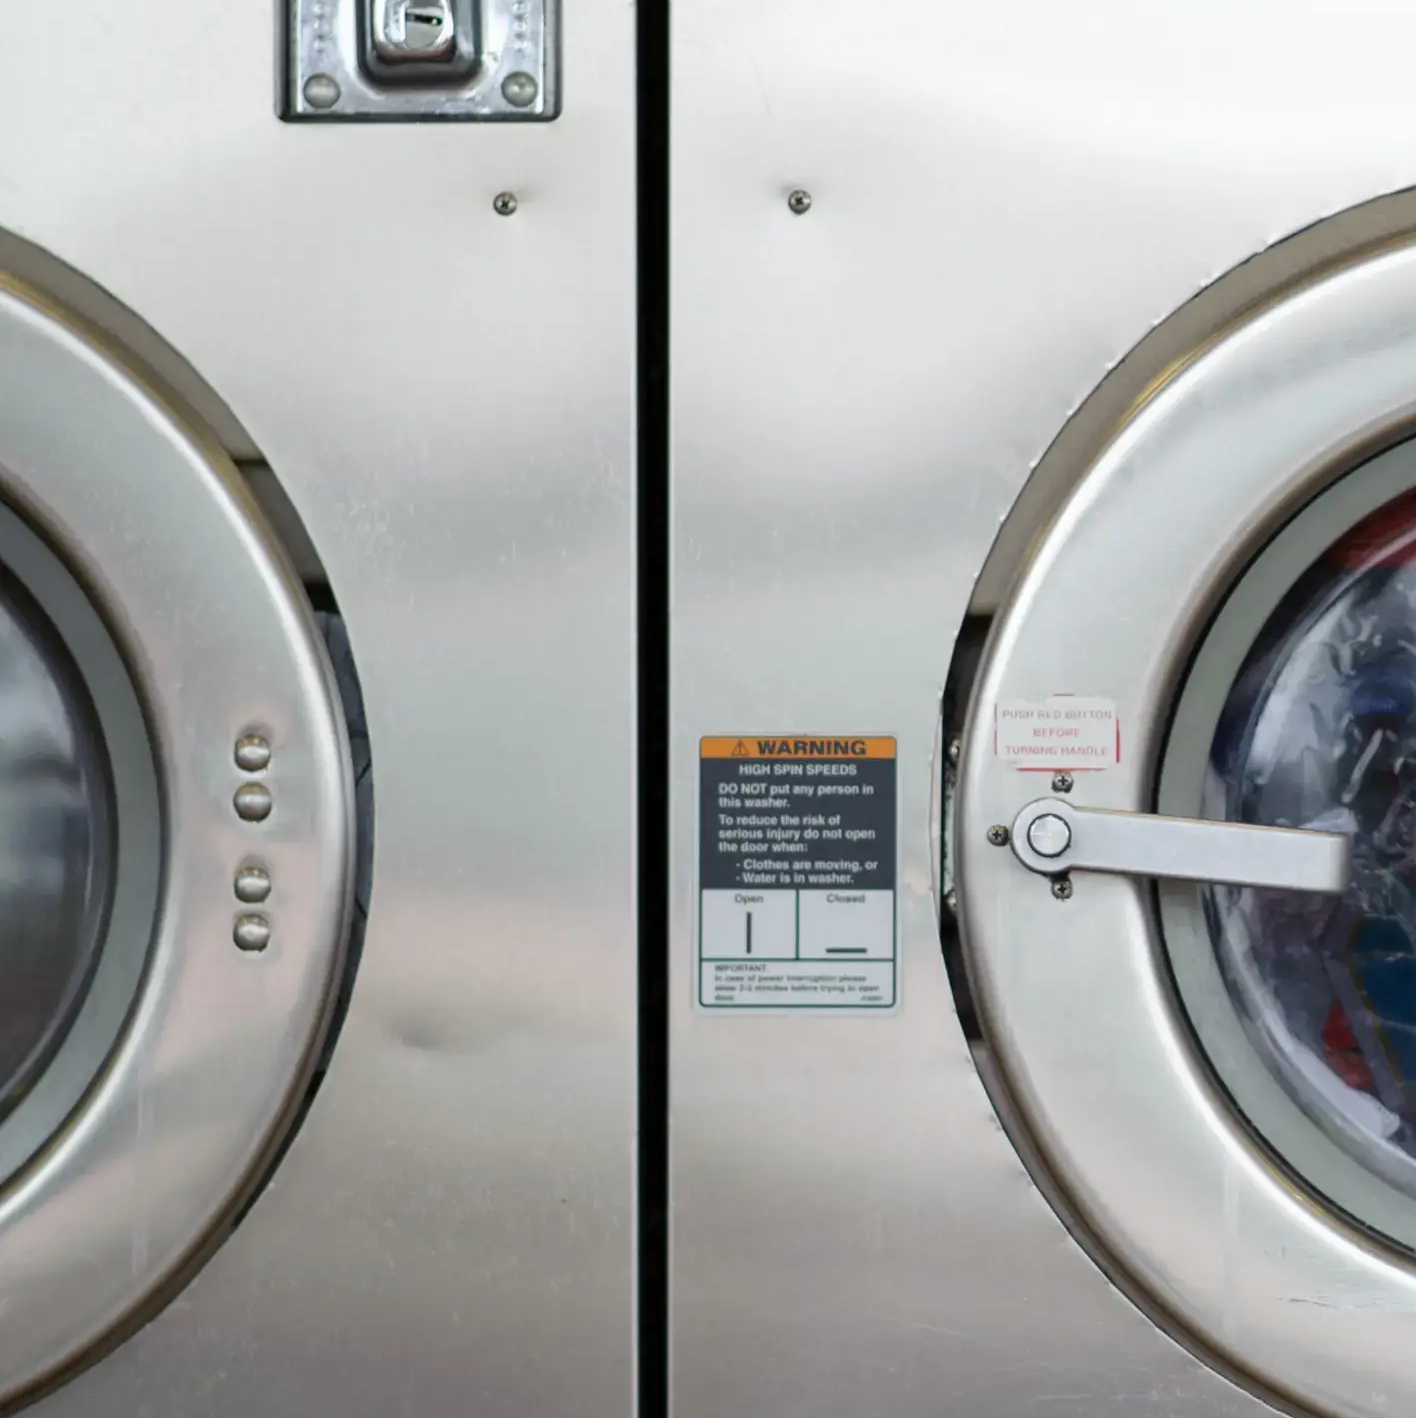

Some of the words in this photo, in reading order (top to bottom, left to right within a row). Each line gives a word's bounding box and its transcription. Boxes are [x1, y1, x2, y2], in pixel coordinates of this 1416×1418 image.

[1033, 728, 1080, 738] BEFORE
[757, 740, 867, 755] WARNING
[739, 764, 770, 776] HIGH
[774, 764, 803, 776] SPIN
[806, 764, 857, 776] SPEEDS
[719, 783, 738, 796] DO
[741, 783, 766, 796] NOT
[770, 783, 790, 796] put
[793, 783, 814, 796] any
[817, 783, 859, 796] person
[862, 783, 874, 796] in
[719, 797, 741, 808] this
[744, 797, 790, 808] washer.
[719, 814, 733, 826] To
[736, 814, 777, 826] reduce
[780, 814, 800, 826] the
[802, 814, 825, 826] risk
[828, 814, 840, 826] of
[719, 828, 763, 841] serious
[766, 828, 800, 841] injury
[803, 828, 819, 841] do
[822, 828, 842, 841] not
[845, 828, 875, 841] open
[719, 841, 738, 852] the
[741, 841, 768, 852] door
[772, 841, 807, 852] when:
[743, 859, 789, 871] Clothes
[792, 859, 812, 871] are
[814, 859, 862, 871] moving,
[865, 859, 877, 871] or
[742, 873, 776, 884] Water
[780, 873, 790, 884] is
[794, 873, 805, 884] in
[808, 873, 854, 884] washer.
[734, 894, 763, 904] Open
[827, 893, 866, 904] Closed
